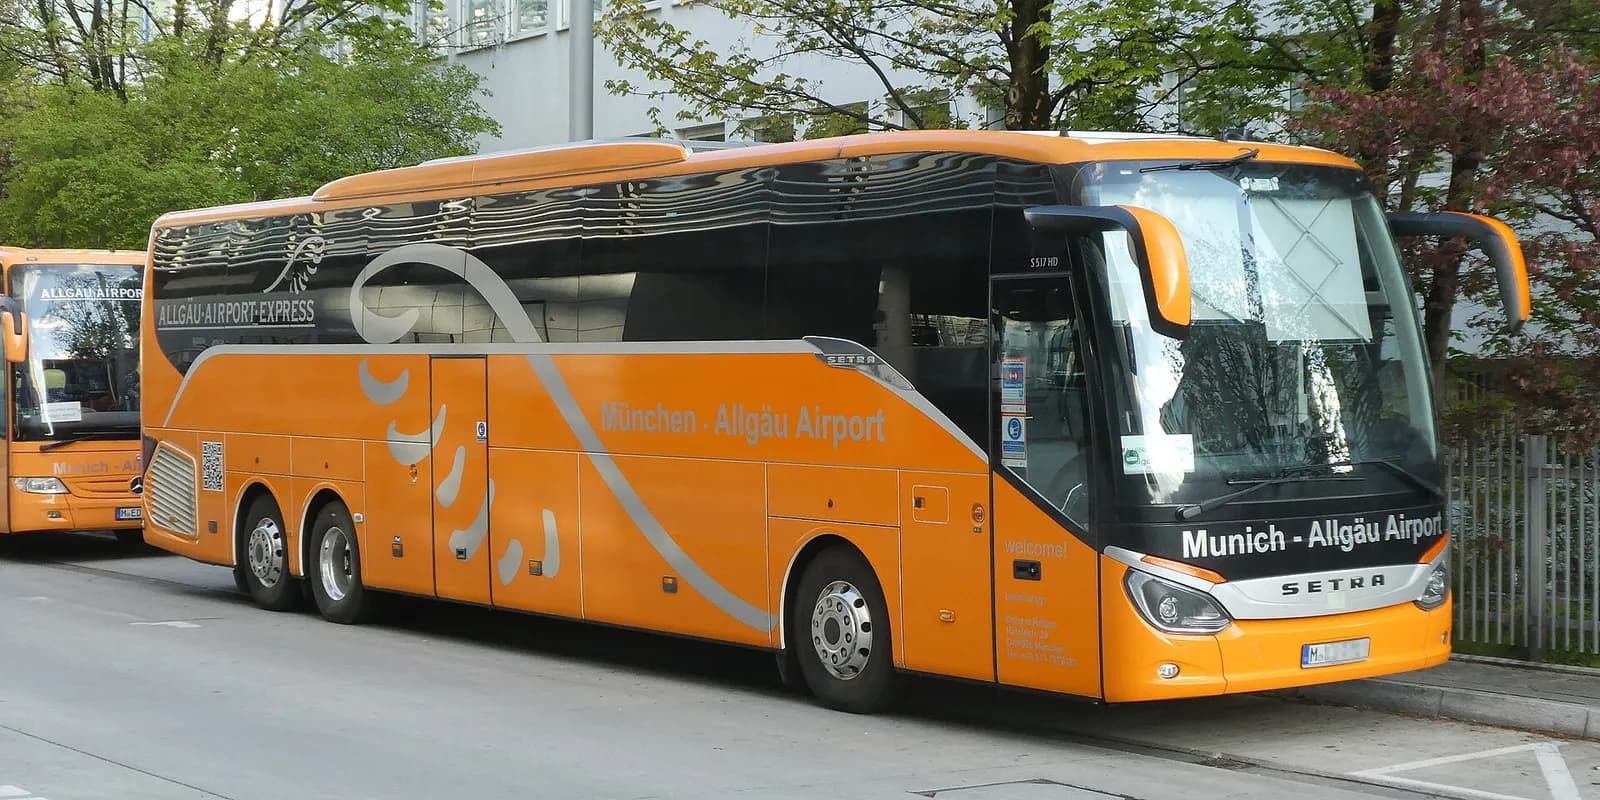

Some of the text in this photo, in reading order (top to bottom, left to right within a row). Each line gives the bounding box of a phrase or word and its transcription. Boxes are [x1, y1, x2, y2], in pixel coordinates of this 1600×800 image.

[827, 355, 876, 364] SETRA
[601, 401, 696, 433] München
[714, 403, 790, 446] Allgäu
[796, 405, 886, 448] Airport
[1182, 524, 1286, 559] Munich
[1308, 517, 1381, 552] Allgäu
[1385, 511, 1442, 545] Airport
[1281, 574, 1386, 596] SETRA
